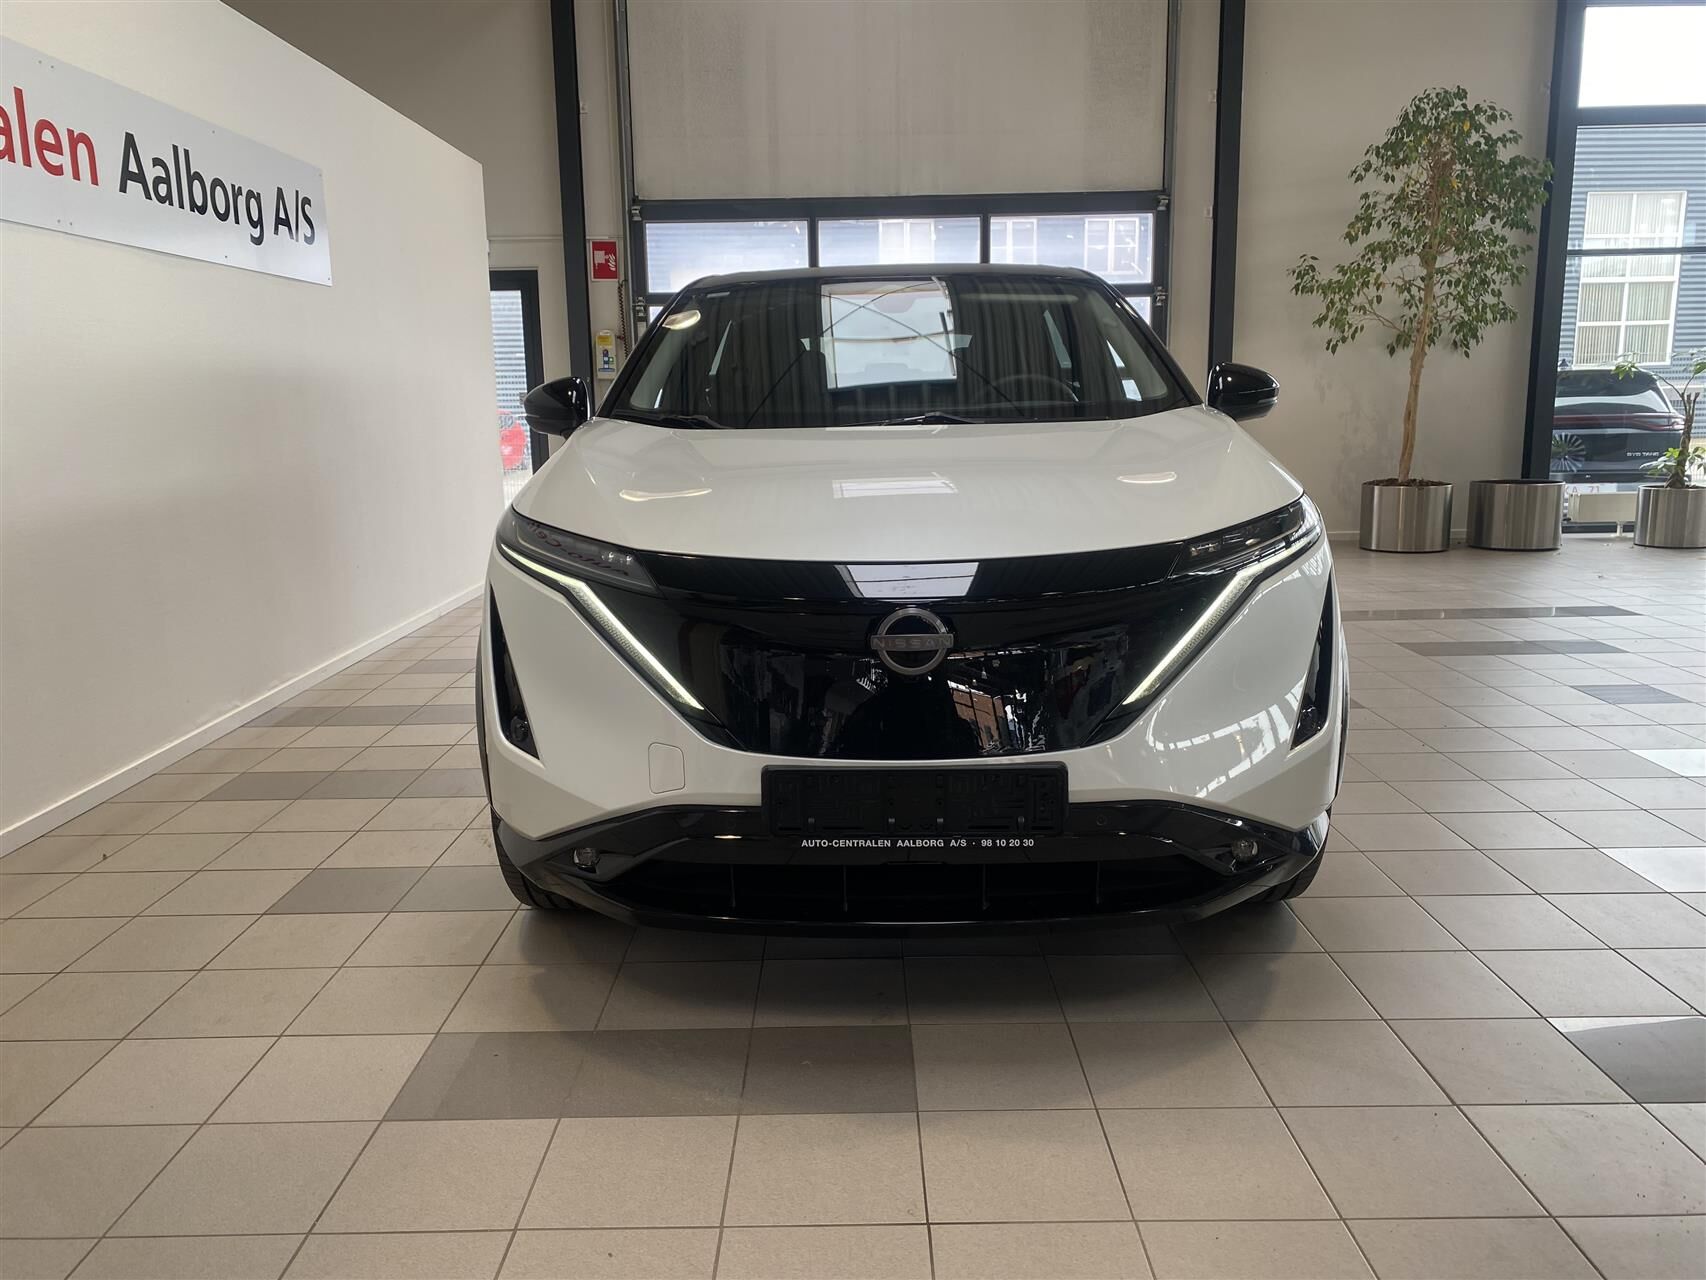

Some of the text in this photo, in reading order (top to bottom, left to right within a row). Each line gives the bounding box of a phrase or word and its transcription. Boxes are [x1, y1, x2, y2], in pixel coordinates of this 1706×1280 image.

[118, 131, 265, 246] Aalborg
[273, 186, 316, 245] A/S
[872, 637, 951, 648] NISSAN
[801, 839, 1035, 848] AUTO-CENTRALEN AALBORG A/S 98 10 20 30
